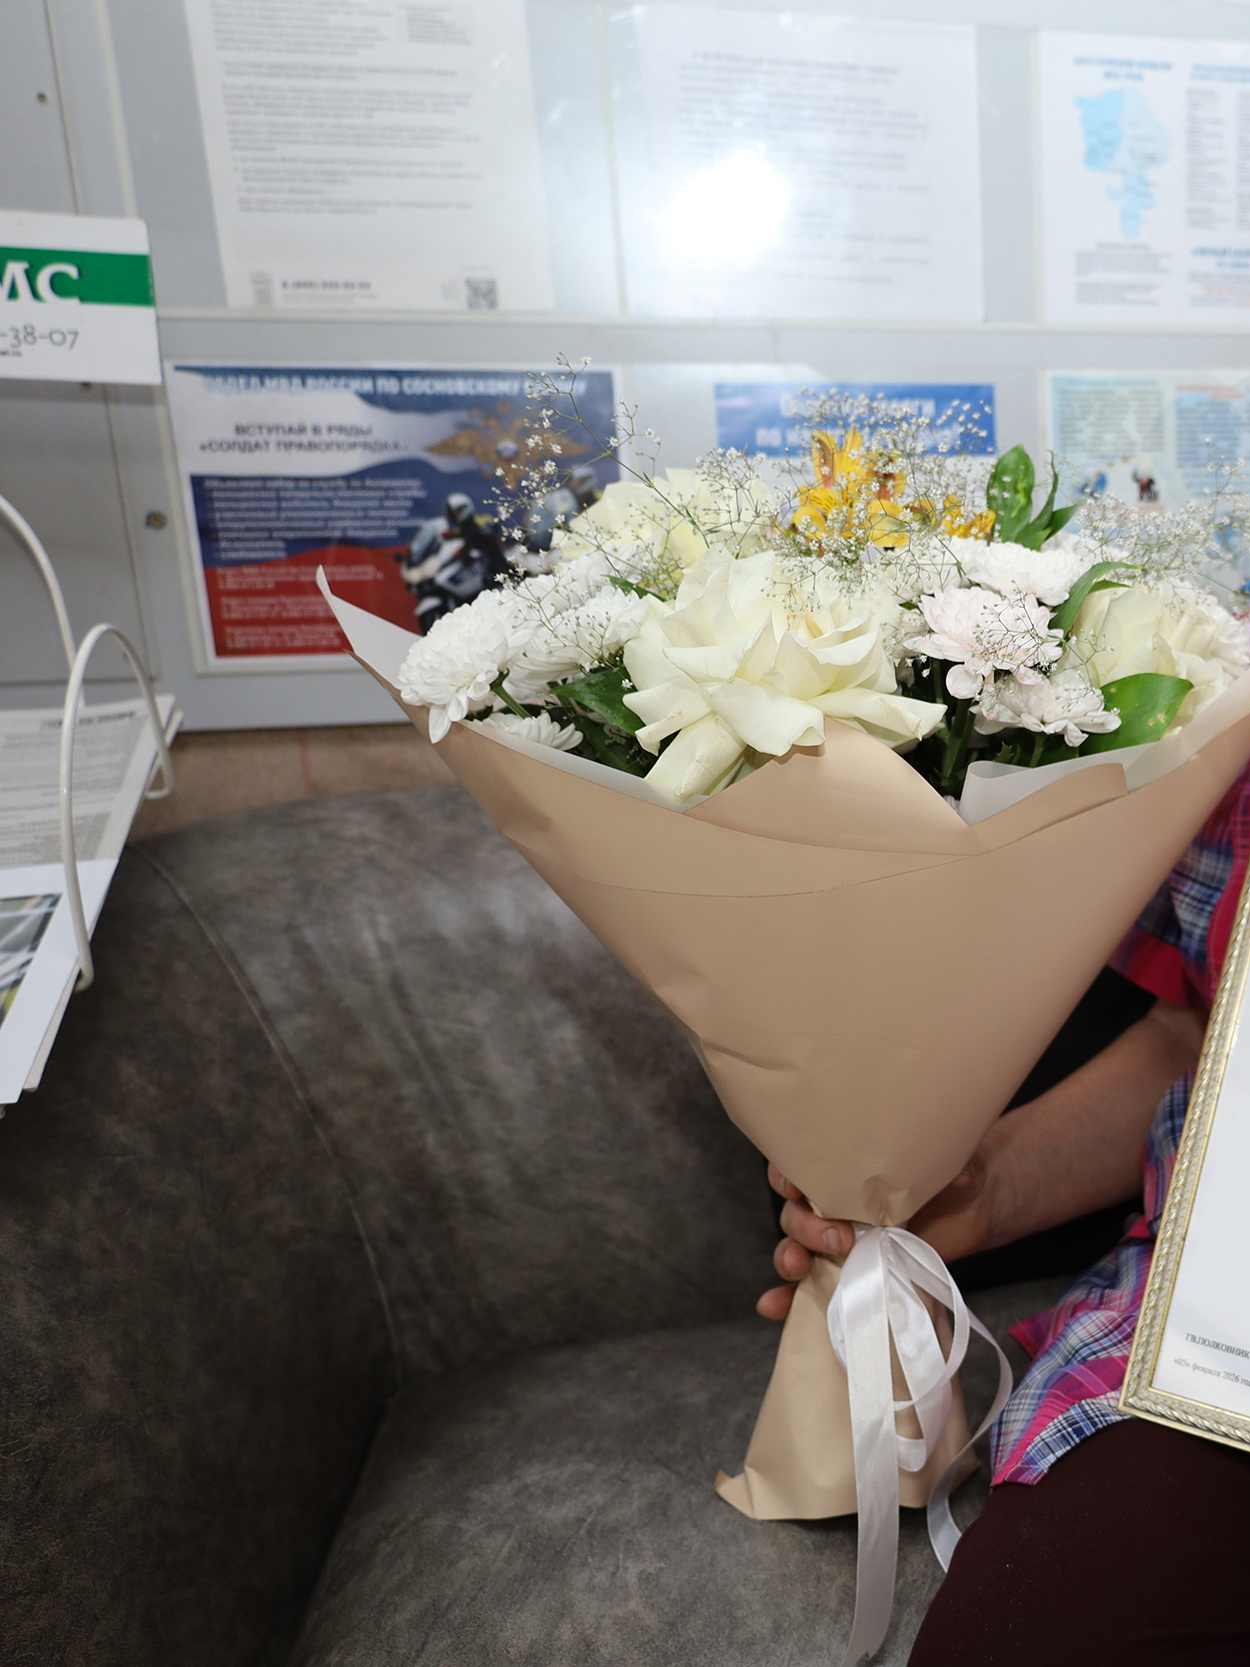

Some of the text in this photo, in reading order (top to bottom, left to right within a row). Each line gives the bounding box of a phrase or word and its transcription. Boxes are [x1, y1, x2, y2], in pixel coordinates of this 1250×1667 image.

[234, 421, 373, 438] ВСТУПАЙ В РЯДЫ
